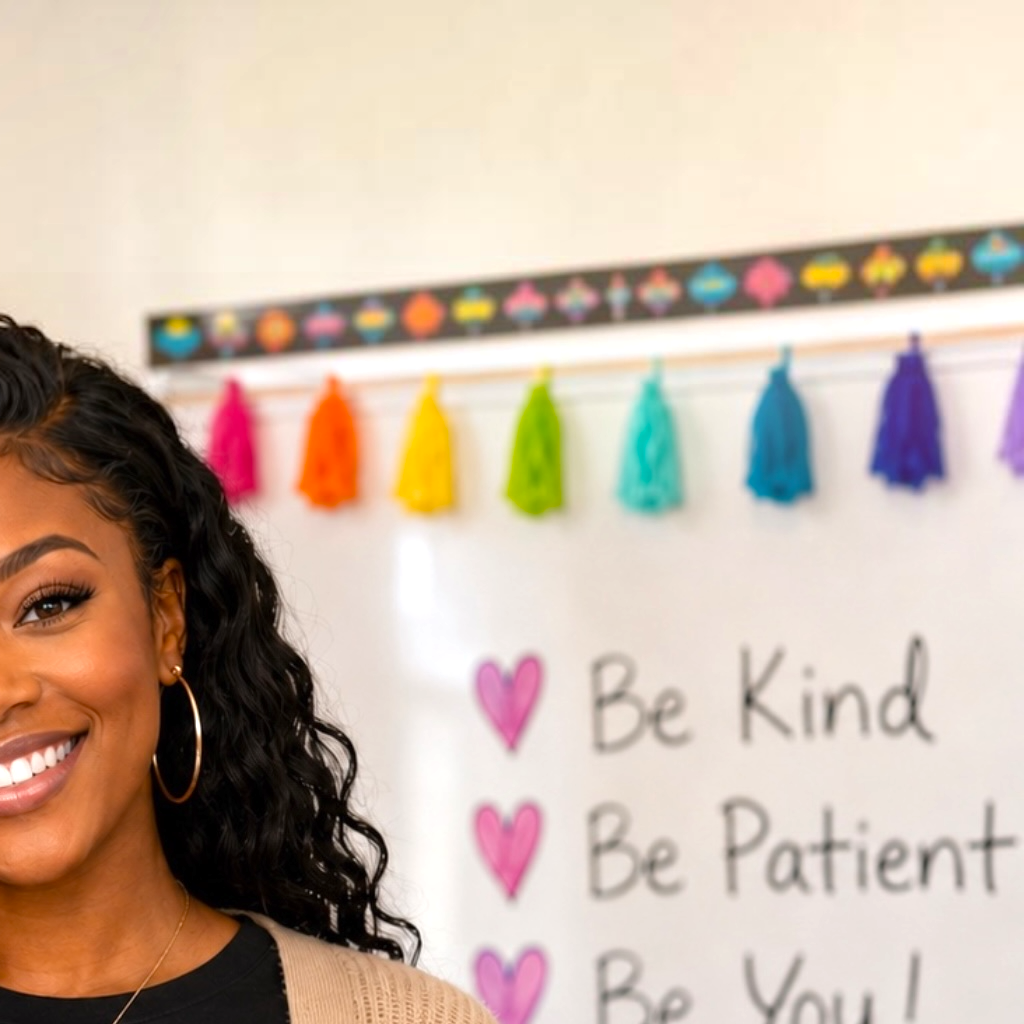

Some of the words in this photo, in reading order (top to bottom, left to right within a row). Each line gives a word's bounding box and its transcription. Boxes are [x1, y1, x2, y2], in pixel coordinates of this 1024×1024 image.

[589, 651, 695, 754] Be
[739, 633, 936, 745] Kind
[588, 801, 686, 900] Be
[720, 797, 1018, 896] Patient
